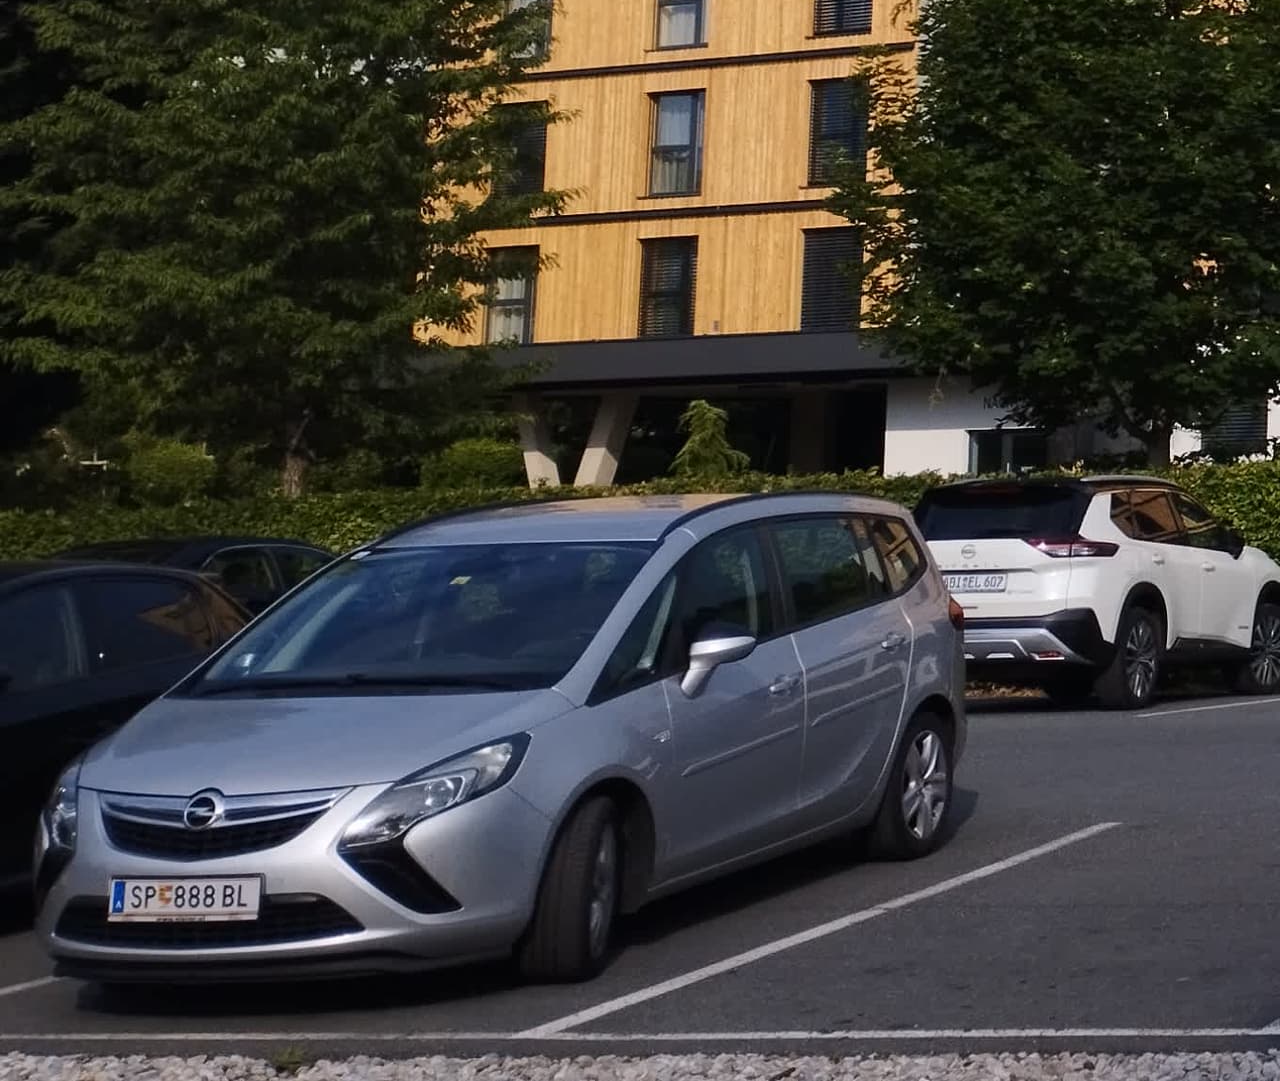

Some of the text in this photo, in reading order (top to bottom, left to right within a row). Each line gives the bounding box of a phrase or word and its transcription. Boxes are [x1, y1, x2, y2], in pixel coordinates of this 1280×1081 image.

[131, 885, 156, 909] SP
[174, 885, 215, 908] 888
[222, 884, 247, 908] BL
